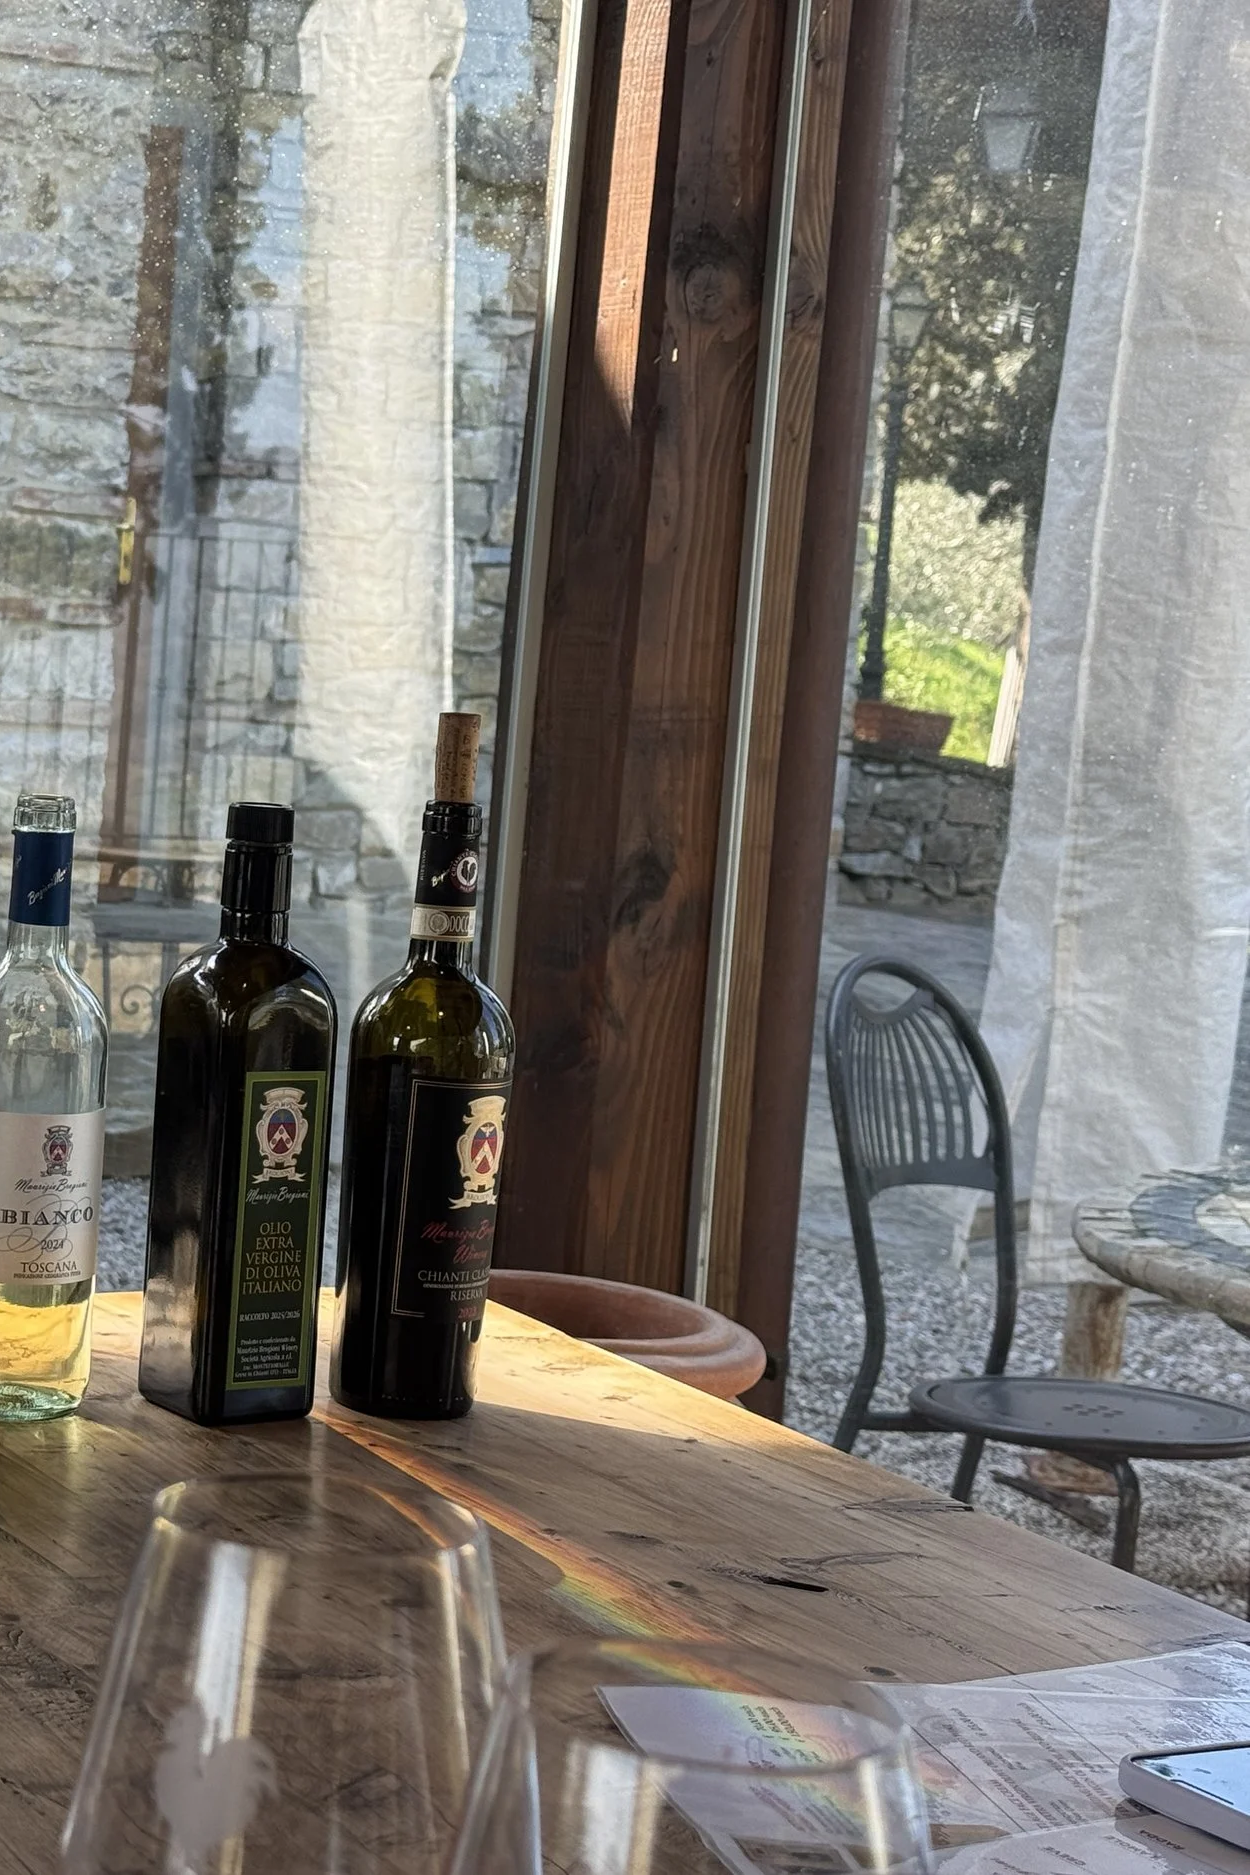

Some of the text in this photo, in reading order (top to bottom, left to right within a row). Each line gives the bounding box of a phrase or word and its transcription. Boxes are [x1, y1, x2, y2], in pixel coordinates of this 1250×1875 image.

[0, 1206, 94, 1225] BIANCO
[260, 1221, 291, 1235] OLIO
[41, 1239, 64, 1250] 2024
[256, 1236, 294, 1250] EXTRA
[246, 1249, 302, 1265] VERGINE
[20, 1261, 77, 1273] TOSCANA
[246, 1265, 300, 1280] DI OLIVA
[417, 1269, 469, 1282] CHIANTI
[242, 1279, 302, 1295] ITALIANO
[449, 1287, 483, 1301] RISERVA
[239, 1312, 270, 1322] RACCOLTO
[1139, 1829, 1185, 1850] RADDA
